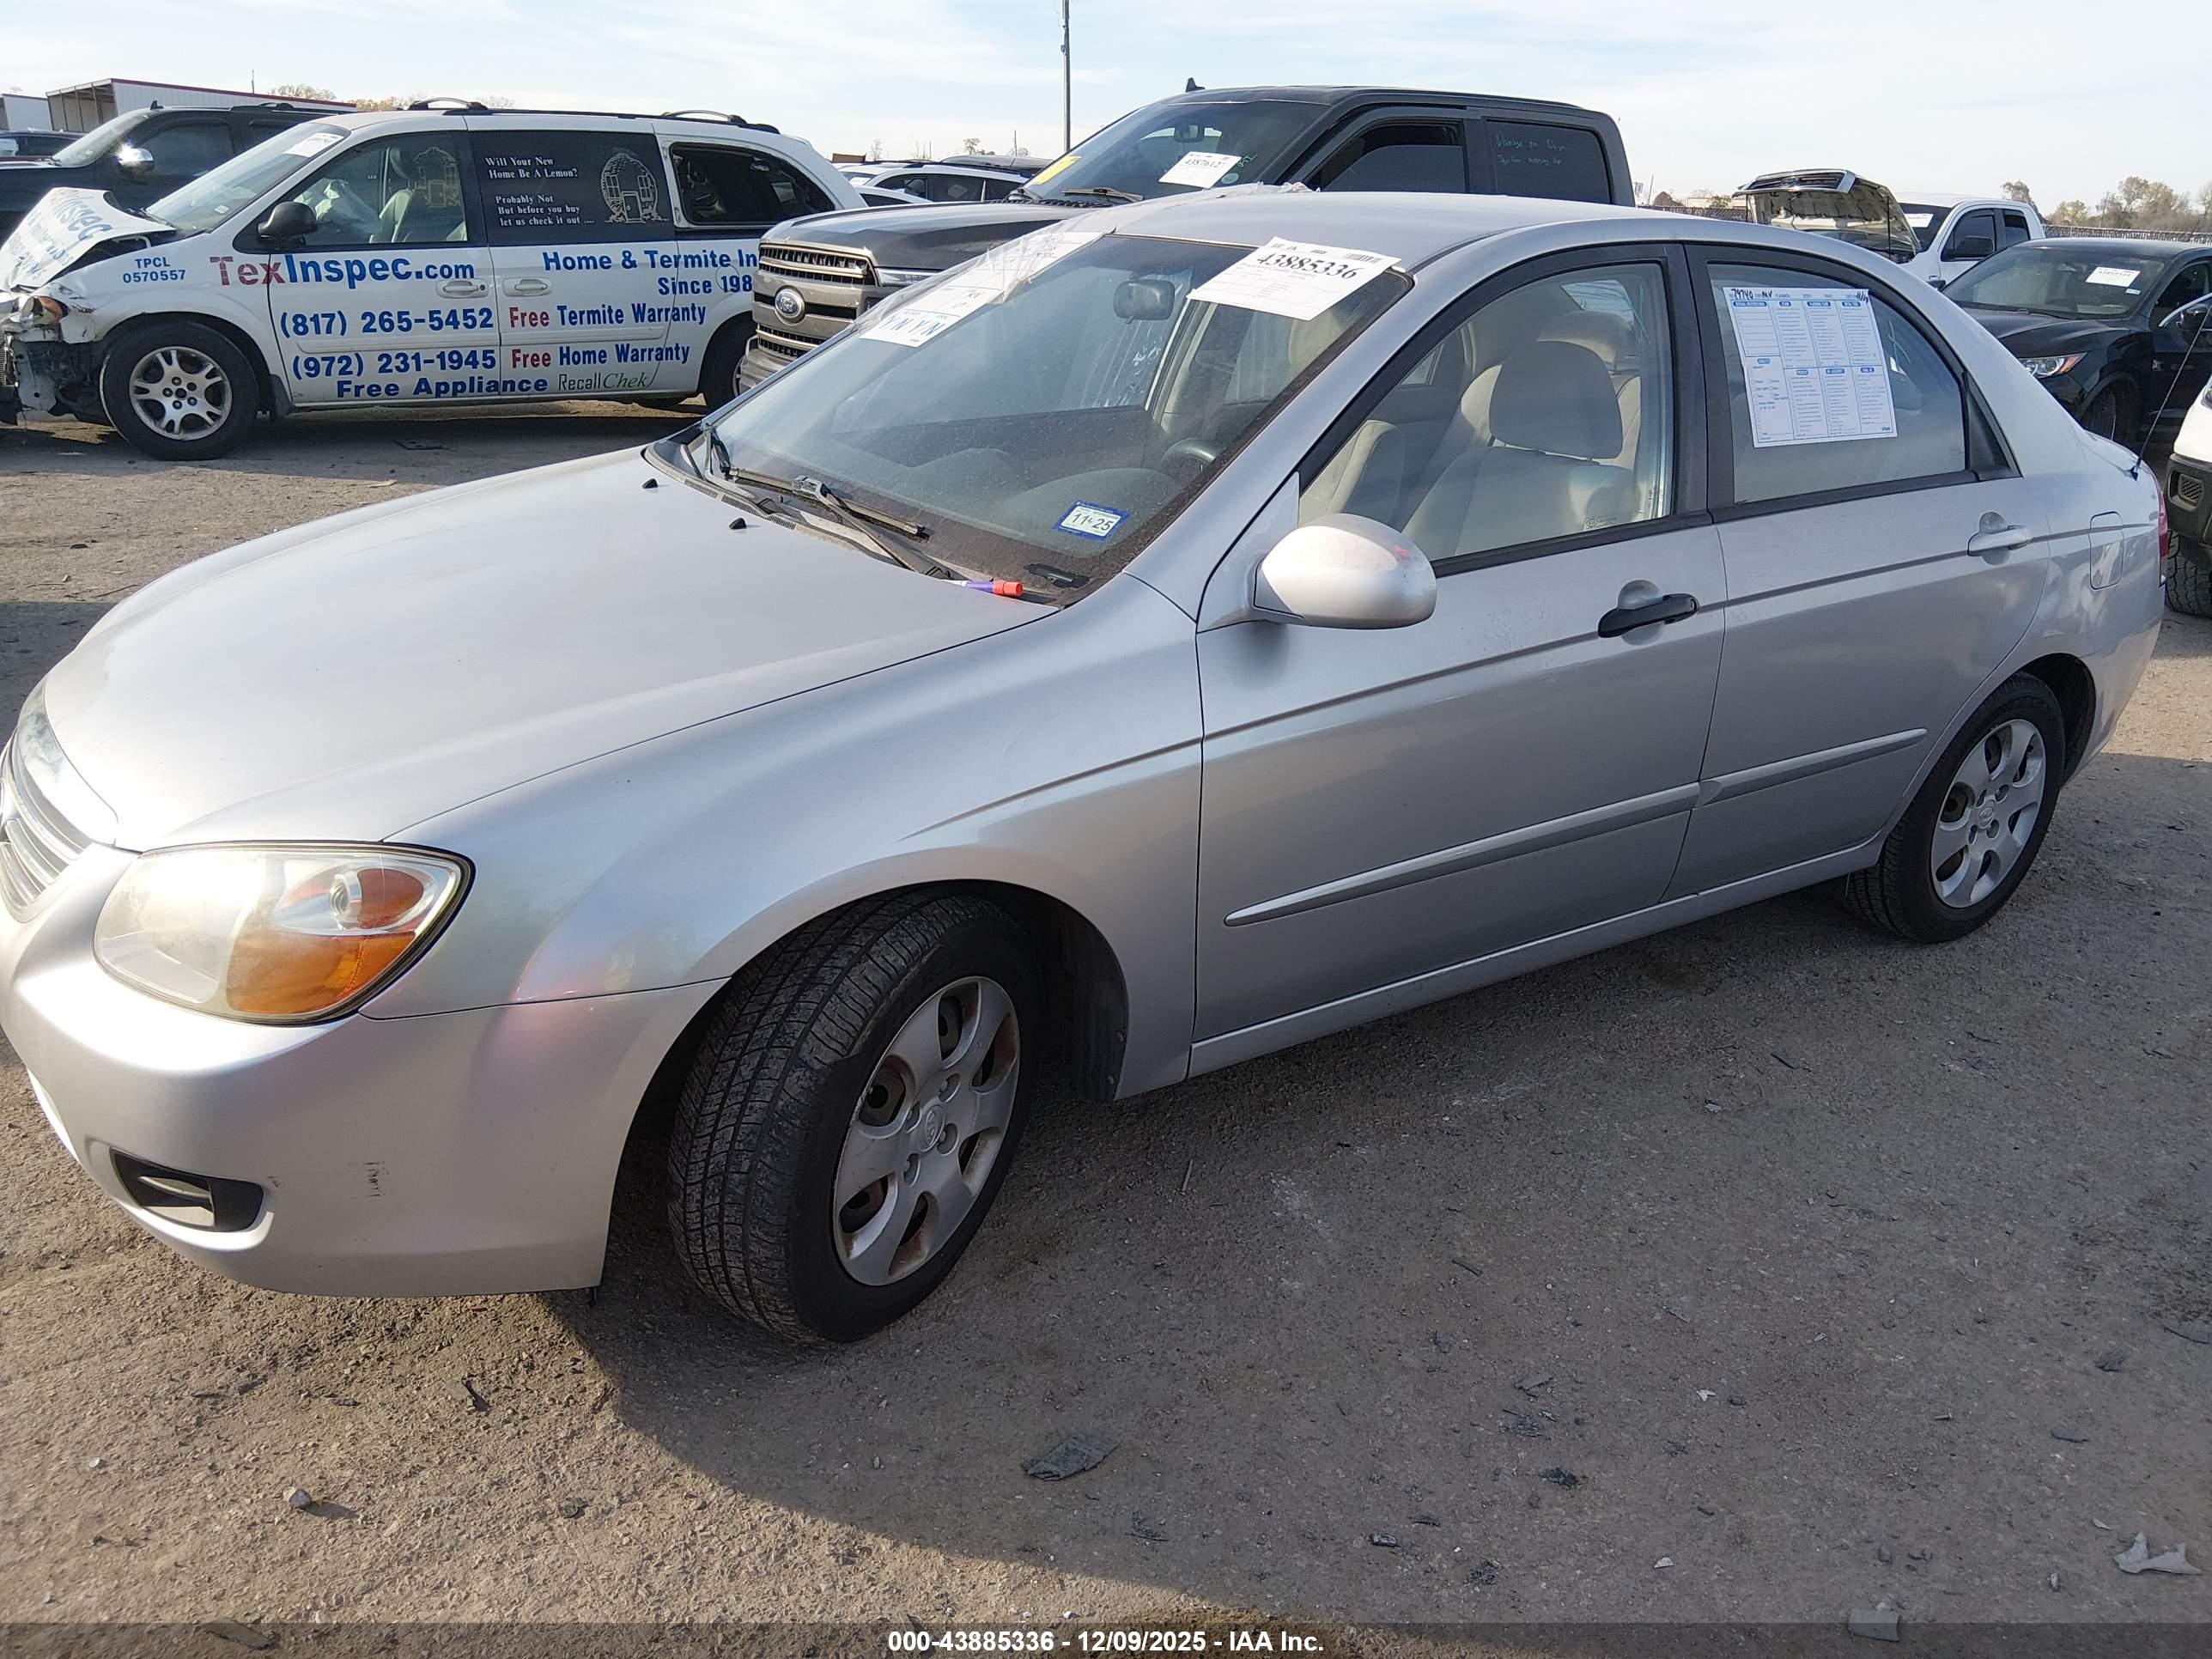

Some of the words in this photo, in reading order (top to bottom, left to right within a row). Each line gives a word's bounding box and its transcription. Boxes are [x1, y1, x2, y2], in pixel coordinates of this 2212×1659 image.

[485, 157, 507, 167] Will
[511, 156, 532, 167] Your
[535, 156, 554, 166] New
[489, 169, 515, 179] Home
[519, 169, 530, 179] Be
[534, 168, 542, 178] A
[544, 168, 578, 179] Lemon?
[495, 195, 533, 205] Probably
[538, 194, 554, 204] Not
[498, 206, 514, 215] But
[517, 205, 544, 214] before
[548, 206, 562, 215] you
[565, 205, 580, 215] buy
[500, 217, 513, 227] let
[528, 216, 554, 226] check
[556, 216, 564, 225] it
[567, 216, 580, 225] out
[135, 257, 171, 269] TPCL
[543, 252, 612, 271] Home
[621, 250, 638, 270] &
[644, 250, 731, 269] Termite
[738, 248, 757, 269] In
[1256, 252, 1365, 279] 43885336
[123, 270, 186, 283] 0570557
[210, 253, 475, 289] TexInspec.com
[658, 276, 713, 295] Since
[720, 274, 753, 293] 198
[280, 310, 347, 338] (817)
[361, 307, 494, 333] 265-5452
[509, 307, 550, 328] Free
[557, 304, 624, 325] Termite
[631, 302, 707, 325] Warranty
[293, 352, 364, 380] (972)
[378, 349, 496, 374] 231-1945
[512, 349, 551, 368] Free
[559, 345, 607, 366] Home
[615, 343, 690, 364] Warranty
[337, 379, 399, 398] Free
[413, 374, 549, 398] Appliance
